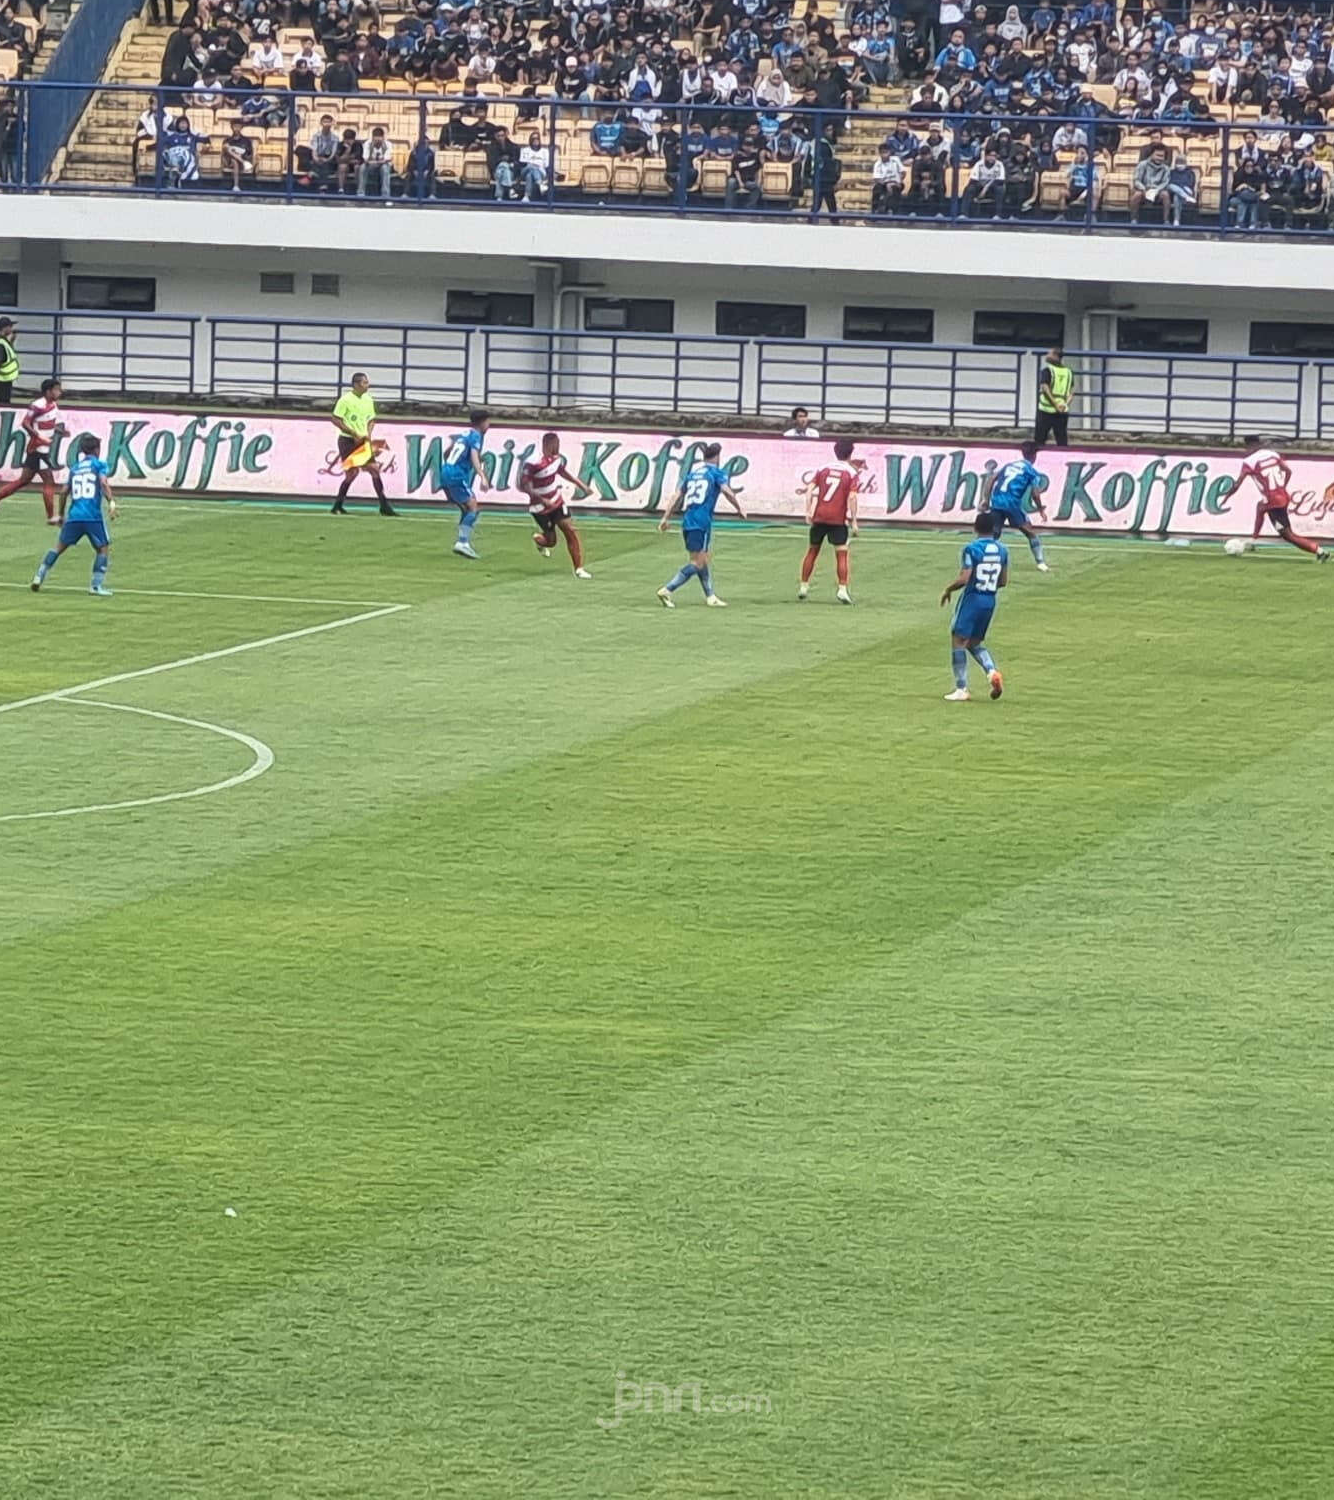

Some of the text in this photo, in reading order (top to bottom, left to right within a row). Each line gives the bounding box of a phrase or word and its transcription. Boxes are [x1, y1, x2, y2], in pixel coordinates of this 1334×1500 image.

[105, 414, 273, 490] Koffie
[71, 472, 98, 500] 66
[681, 479, 709, 512] 23
[822, 476, 842, 502] 7
[1053, 457, 1234, 532] Koffie
[974, 563, 1003, 592] 53
